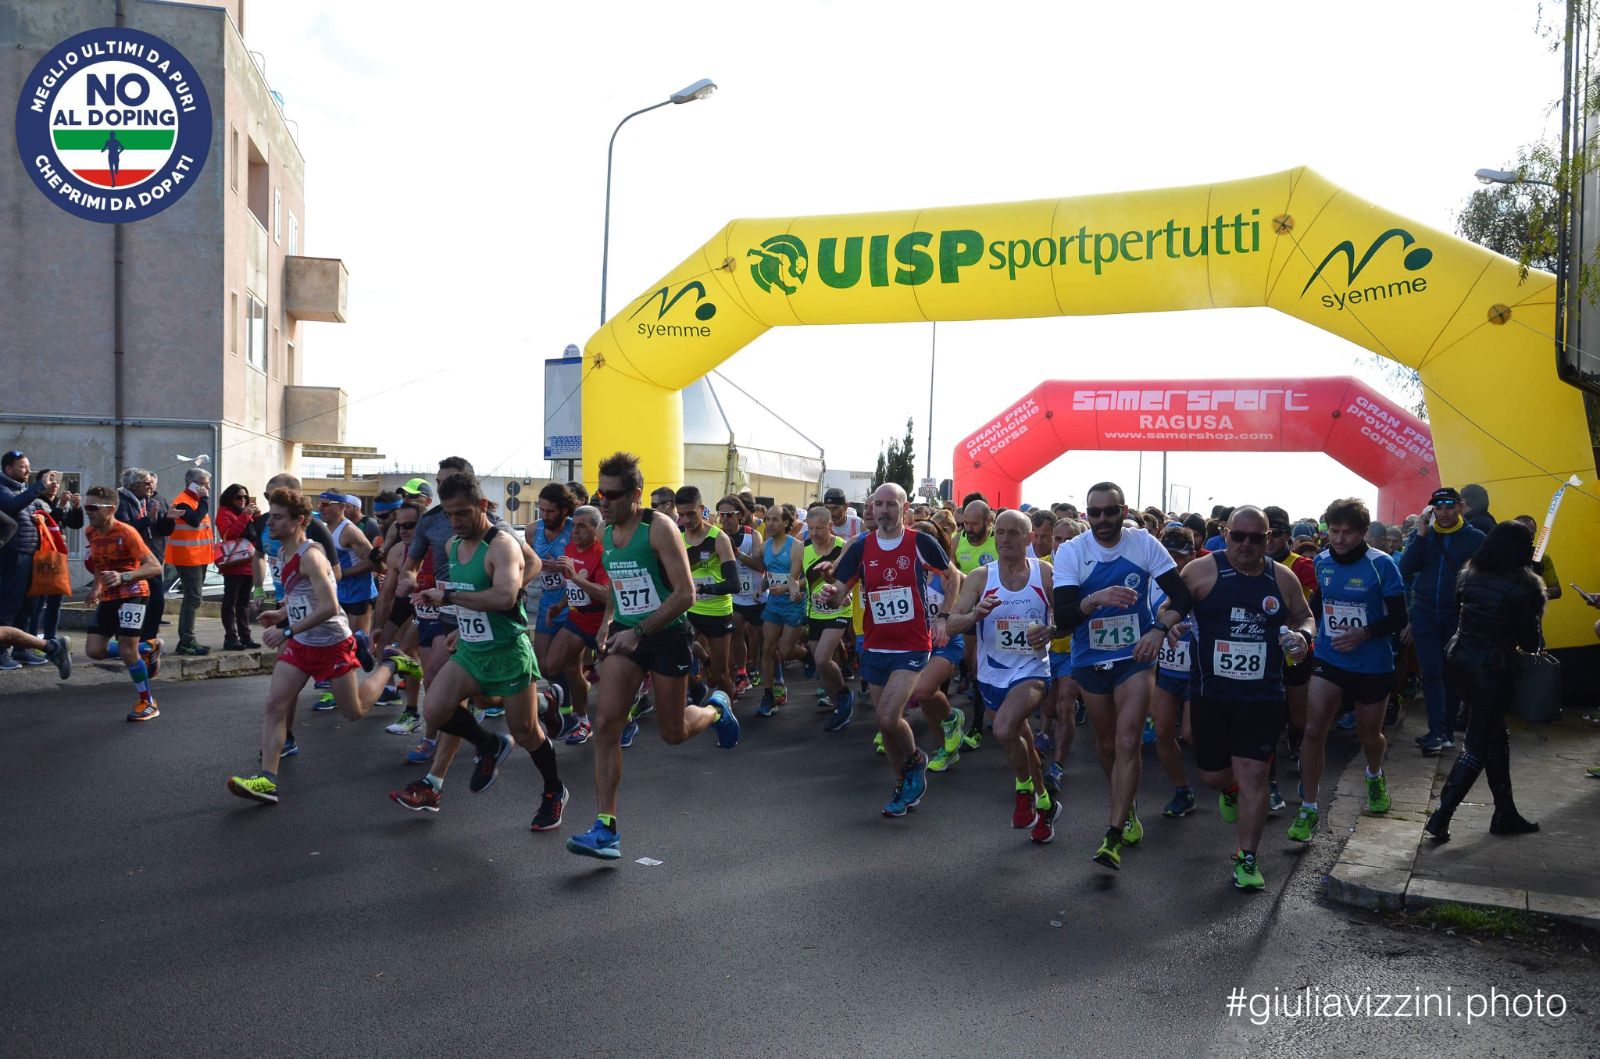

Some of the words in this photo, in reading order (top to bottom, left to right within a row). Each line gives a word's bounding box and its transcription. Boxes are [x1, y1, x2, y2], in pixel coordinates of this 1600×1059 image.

[817, 229, 984, 289] UISP
[988, 208, 1260, 281] sportpertutti
[1320, 276, 1428, 311] syemme
[637, 322, 711, 338] syemme
[1355, 396, 1401, 429] GRAN
[966, 420, 1002, 450] GRAN
[1004, 398, 1037, 423] PRIX
[969, 404, 1041, 459] provinciale
[1139, 415, 1233, 430] RAGUSA
[989, 424, 1029, 455] corsa
[1104, 431, 1274, 441] www.samershop.com
[1346, 404, 1435, 463] provinciale
[1360, 426, 1407, 460] corsa
[620, 588, 651, 607] 577
[875, 599, 909, 617] 319
[1001, 631, 1033, 648] 34
[1094, 626, 1136, 645] 713
[1158, 648, 1185, 665] 681
[1220, 653, 1261, 672] 528
